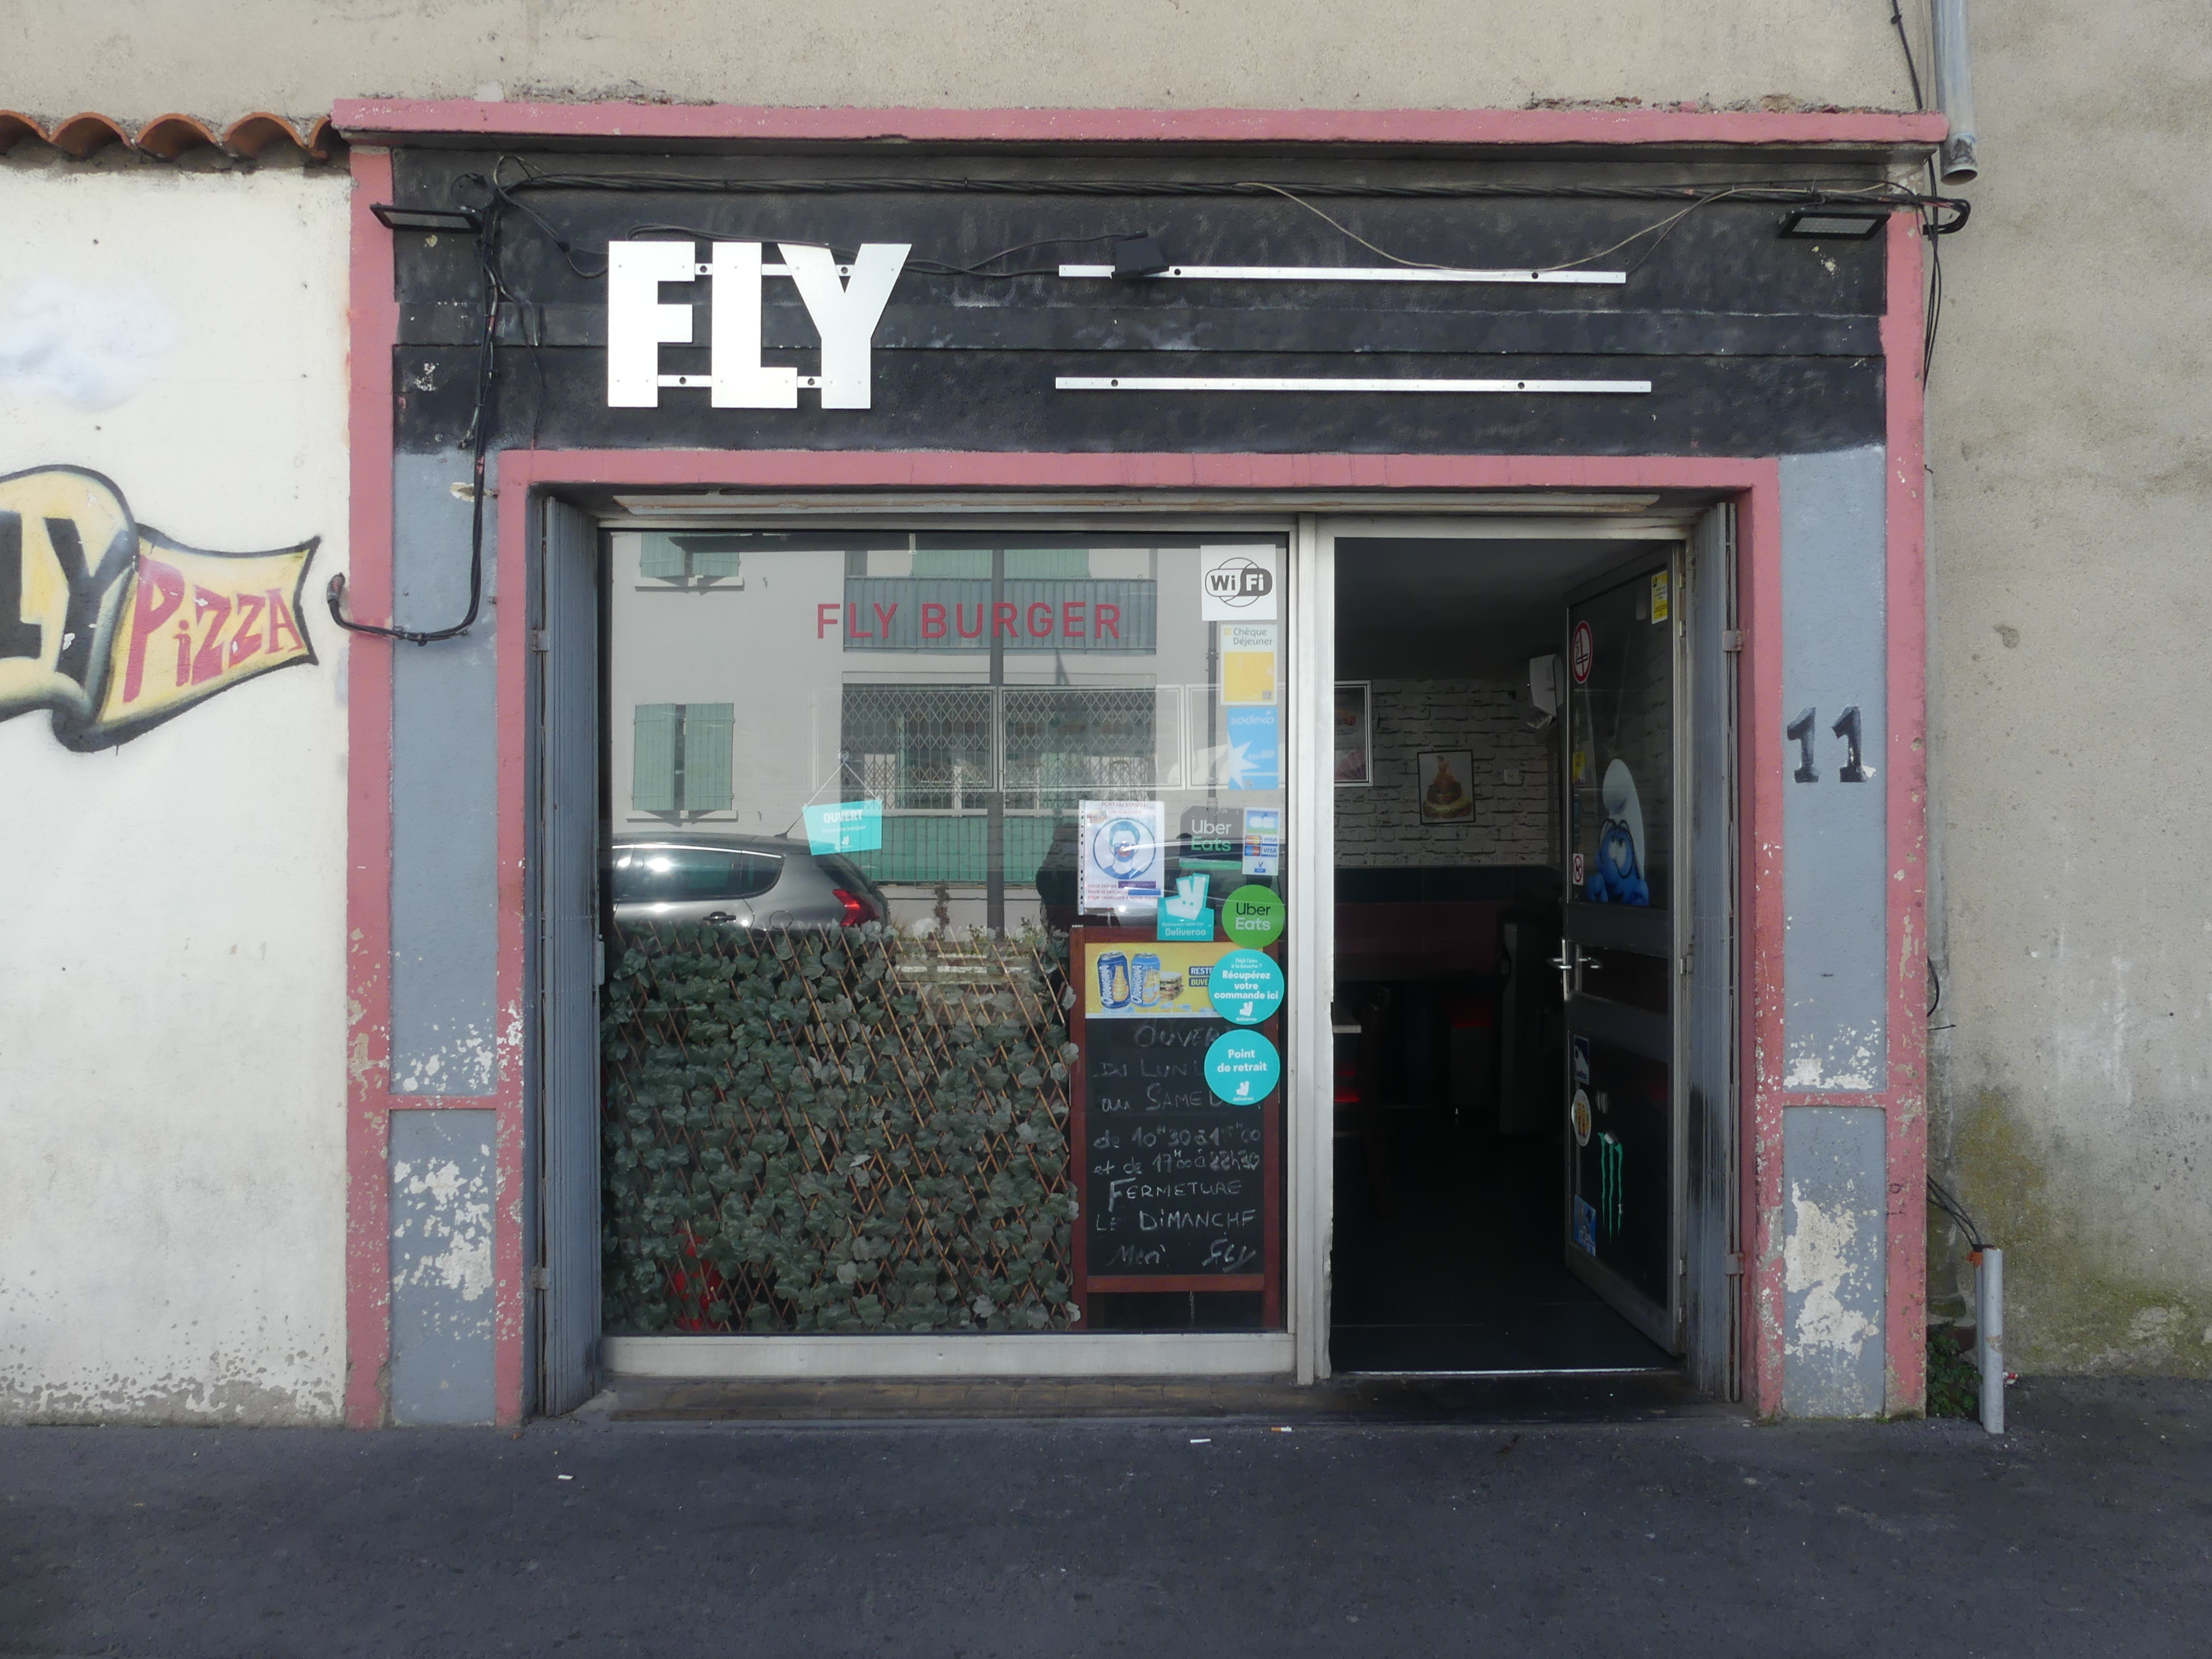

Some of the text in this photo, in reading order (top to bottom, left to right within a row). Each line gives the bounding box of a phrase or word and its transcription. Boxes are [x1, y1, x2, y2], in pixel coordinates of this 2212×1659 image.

[608, 241, 912, 409] FLY
[817, 601, 1120, 639] FLY BURGER
[1233, 628, 1267, 637] Chèque
[1233, 637, 1273, 646] Déjeuner
[1230, 713, 1274, 725] sodexo
[1787, 706, 1867, 783] 11
[823, 810, 863, 823] OUVERT
[1192, 819, 1232, 834] Uber
[1191, 836, 1232, 852] Eats
[1235, 902, 1271, 916] Uber
[1165, 927, 1207, 936] Deliveroo
[1235, 918, 1271, 931] Eats
[1222, 969, 1271, 981] Récupérez
[1099, 964, 1114, 1005] ORANGINA
[1131, 964, 1144, 1004] ORANGINA
[1214, 990, 1279, 999] commande ici
[1134, 1025, 1230, 1047] OUVER
[1228, 1048, 1255, 1058] Point
[1217, 1061, 1267, 1072] de retrait
[1093, 1129, 1120, 1149] de
[1093, 1160, 1115, 1175] et
[1123, 1156, 1143, 1175] de
[1108, 1177, 1242, 1213] FERMETURE
